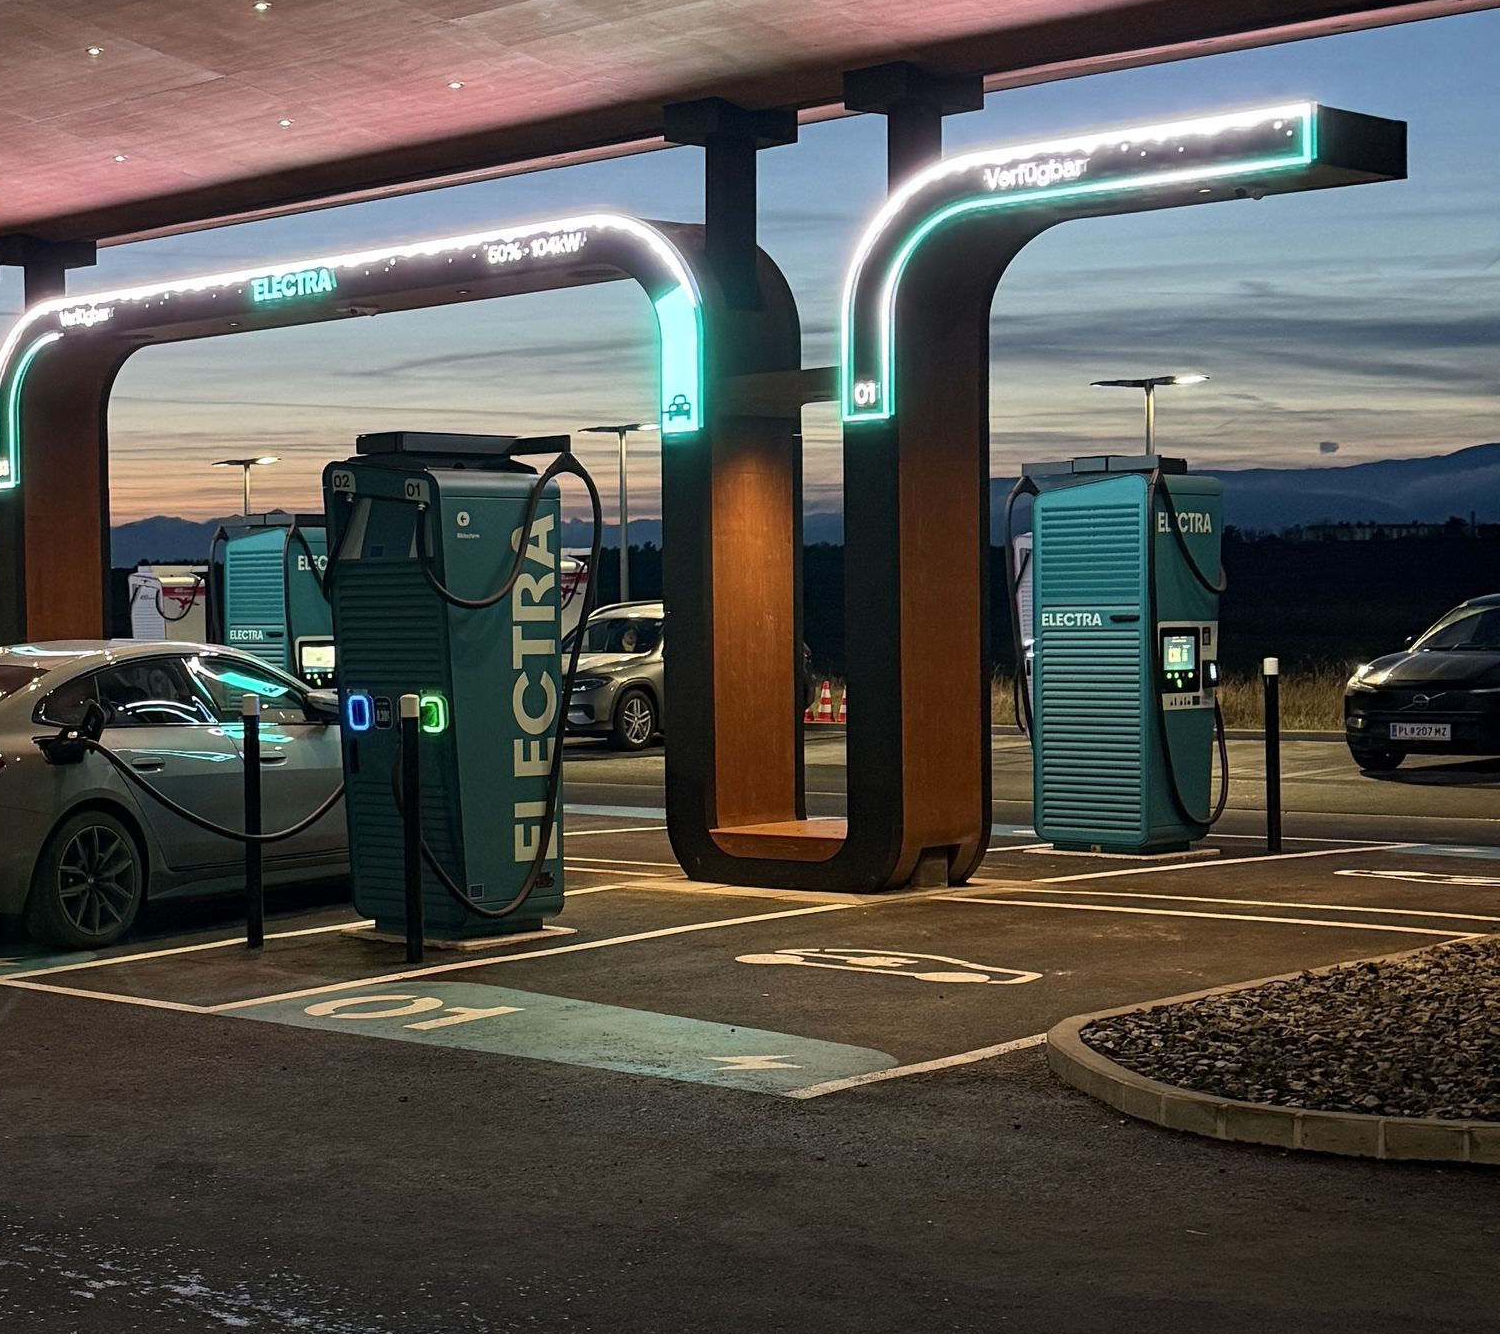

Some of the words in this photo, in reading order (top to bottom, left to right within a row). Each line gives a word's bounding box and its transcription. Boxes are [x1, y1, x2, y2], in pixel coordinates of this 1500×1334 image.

[252, 267, 334, 302] ELECTRA
[854, 381, 876, 405] 01
[333, 474, 351, 489] 02
[406, 482, 422, 498] 01
[1157, 511, 1213, 534] ELCTRA
[1041, 612, 1103, 627] ELECTRA
[229, 629, 264, 641] ELECTRA
[511, 513, 558, 863] ELECTRA
[303, 994, 526, 1031] 01
